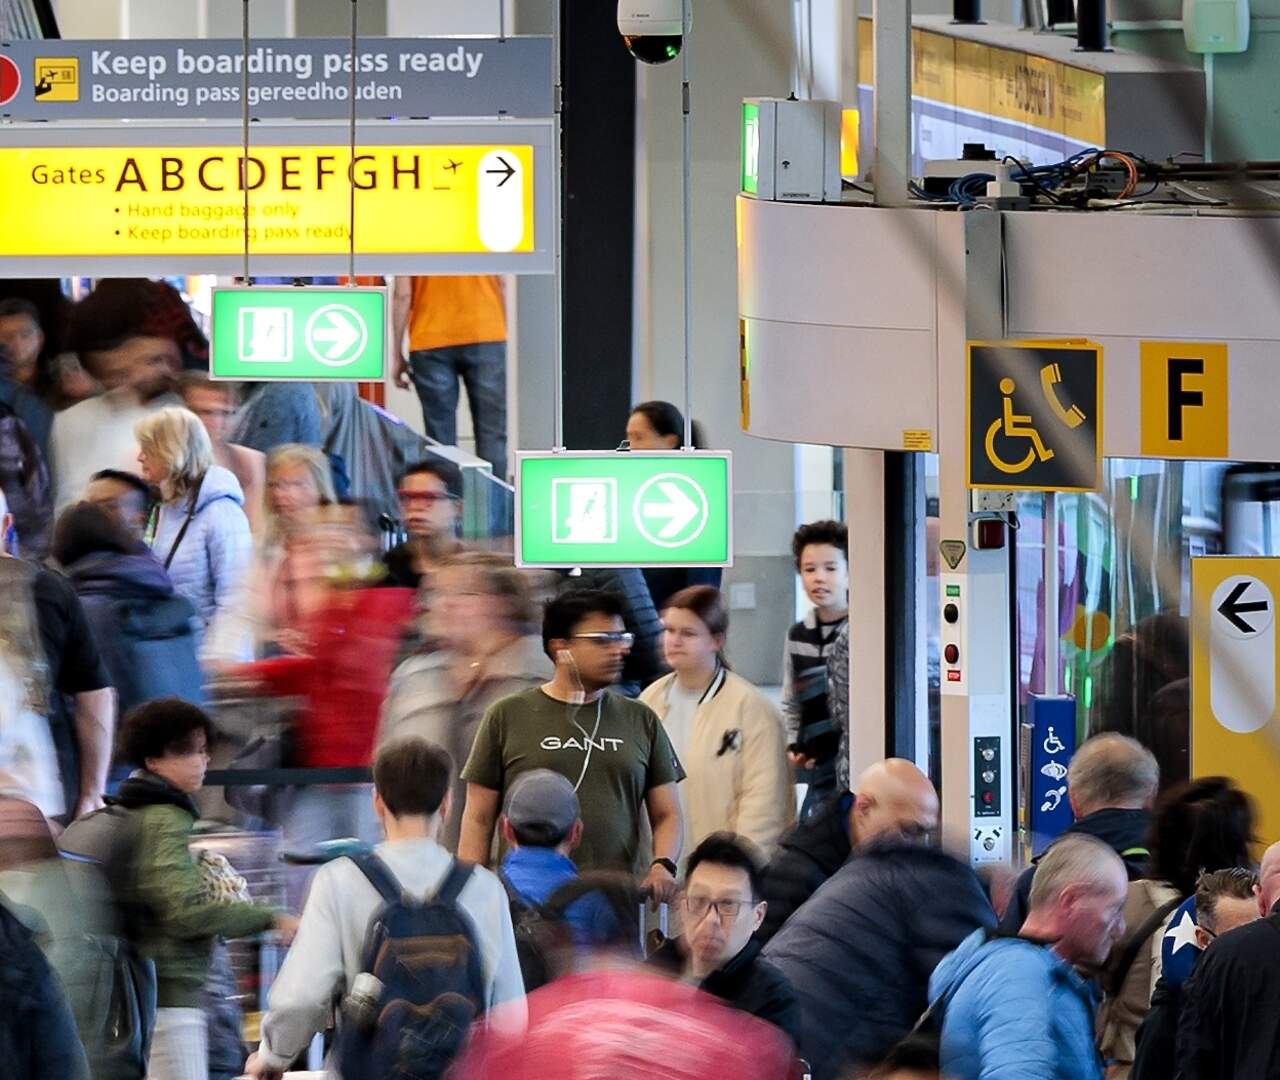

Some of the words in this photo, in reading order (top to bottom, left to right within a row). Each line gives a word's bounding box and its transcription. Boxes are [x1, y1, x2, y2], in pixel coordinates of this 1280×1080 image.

[91, 50, 167, 80] Keep
[177, 49, 313, 79] boarding
[323, 50, 388, 79] pass
[399, 46, 483, 78] ready
[91, 82, 190, 106] Boarding
[198, 86, 241, 105] pass
[247, 80, 402, 106] gereedhouden
[31, 163, 105, 186] Gates
[127, 202, 174, 218] Hand
[180, 202, 256, 222] baggage
[262, 201, 300, 221] only
[127, 225, 172, 243] Keep
[177, 224, 258, 243] boarding
[263, 227, 300, 243] pass
[305, 225, 353, 243] ready
[1167, 357, 1205, 441] F
[539, 736, 624, 752] GANT
